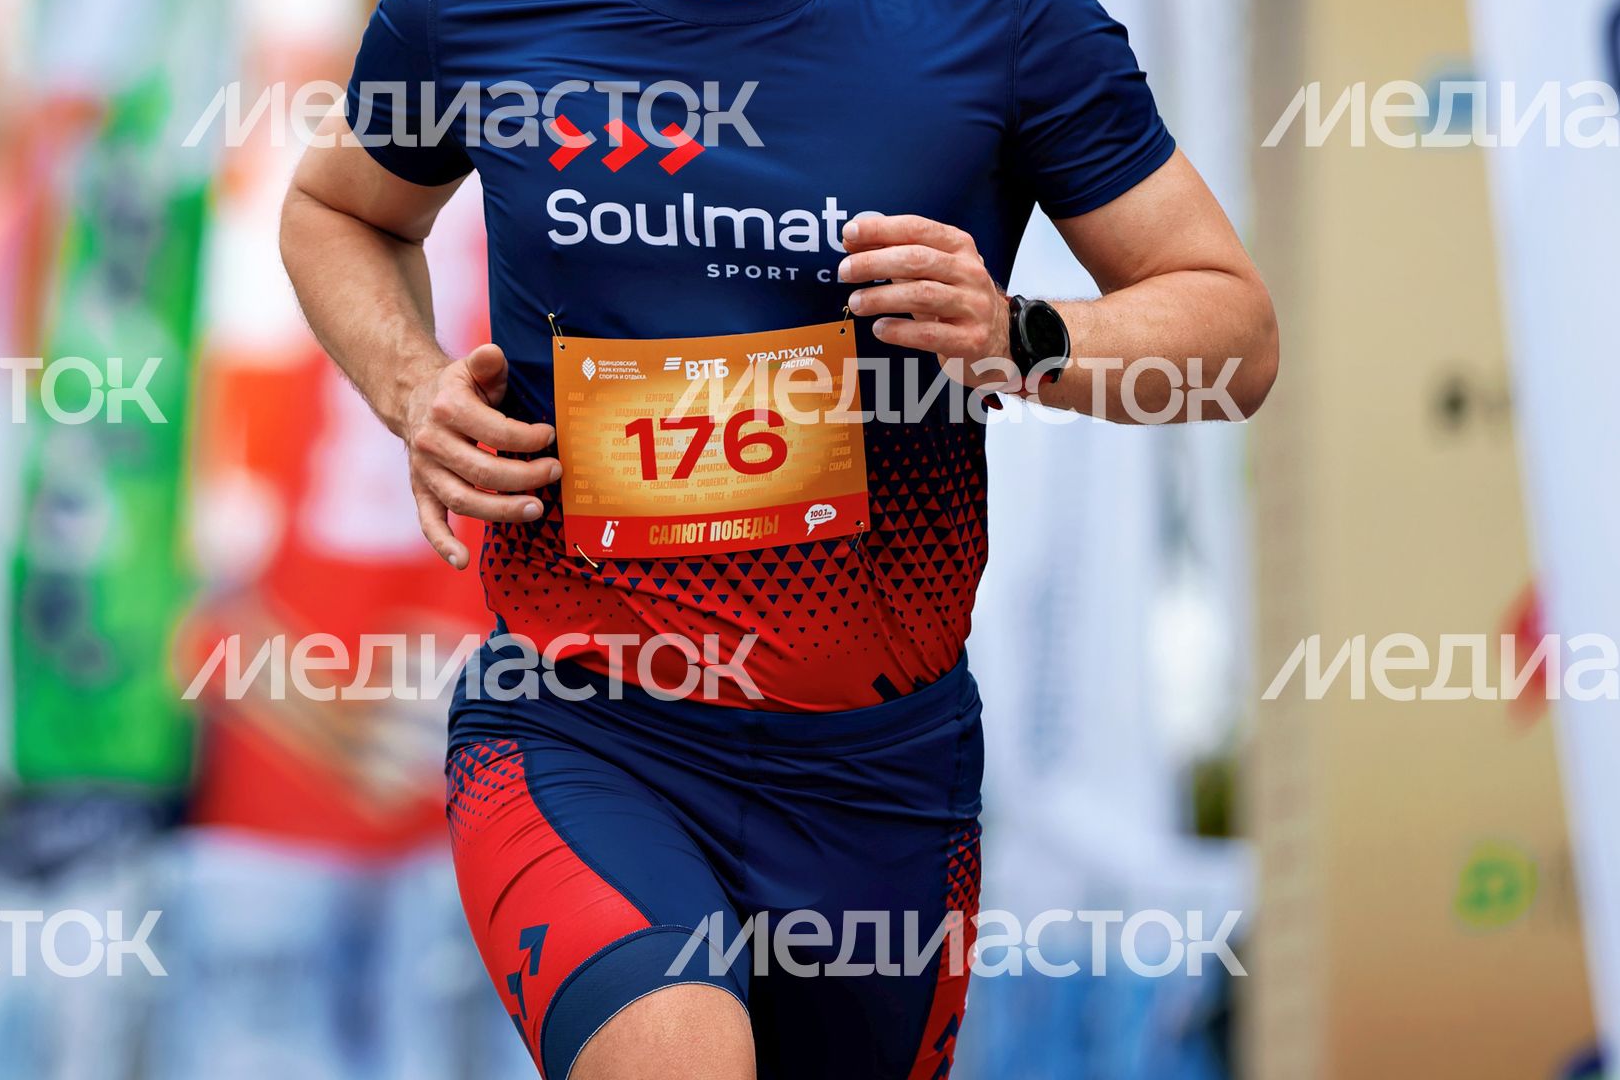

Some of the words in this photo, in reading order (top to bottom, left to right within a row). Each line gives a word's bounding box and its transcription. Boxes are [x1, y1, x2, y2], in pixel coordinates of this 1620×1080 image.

[546, 189, 886, 253] Soulmat
[706, 263, 799, 281] SPORT
[746, 344, 824, 363] УРАЛХИМ
[780, 357, 816, 370] FACTORY
[685, 358, 729, 380] ВТБ
[624, 408, 788, 480] 176
[649, 520, 706, 545] САЛЮТ
[709, 514, 779, 542] ПОБЕДЫ
